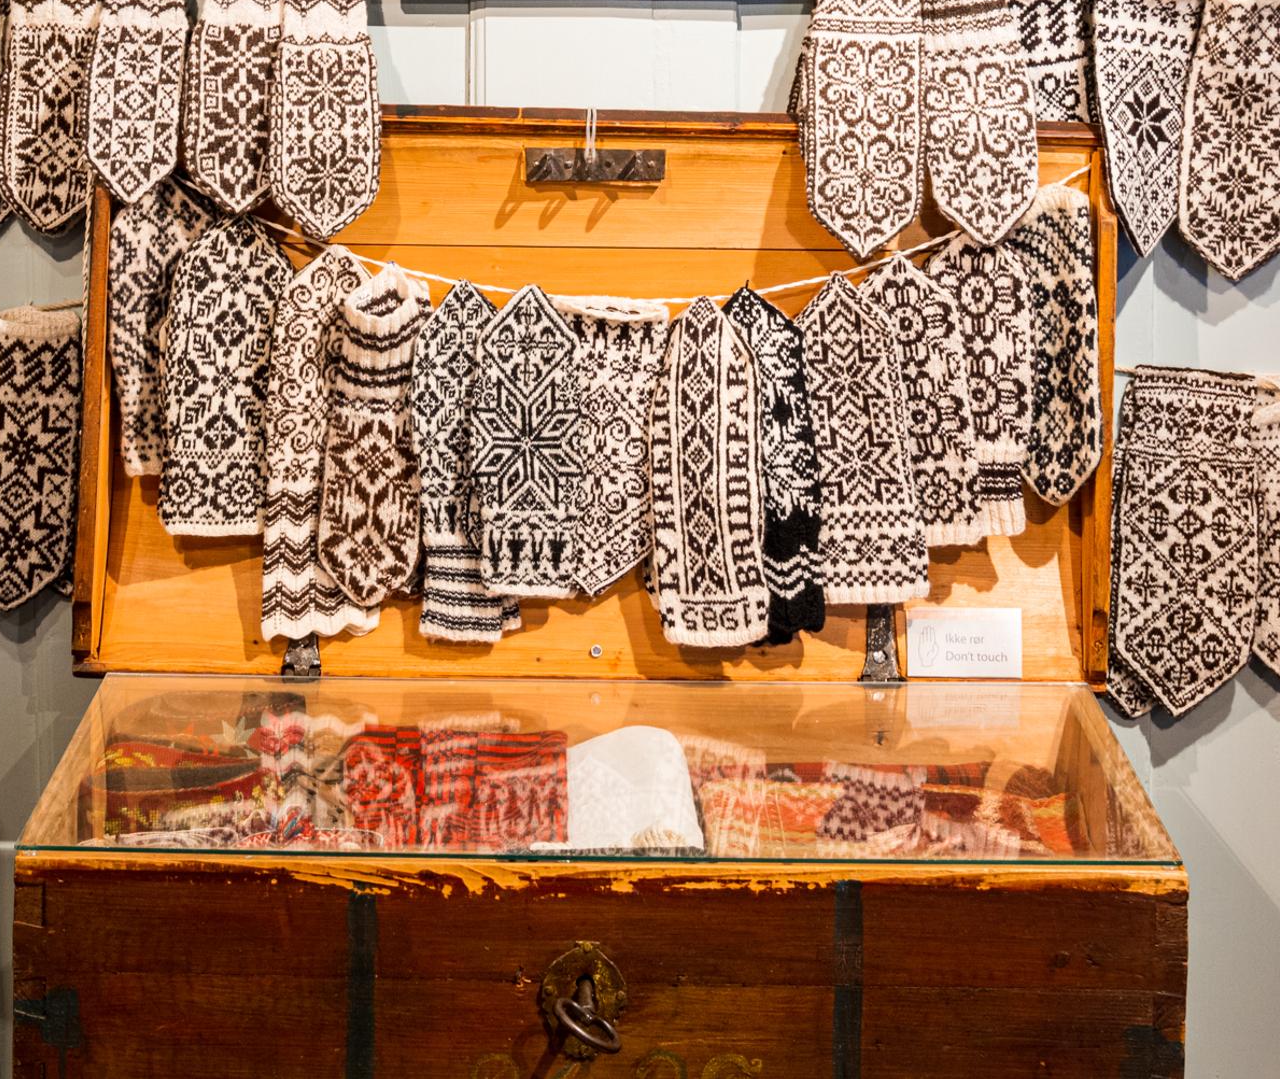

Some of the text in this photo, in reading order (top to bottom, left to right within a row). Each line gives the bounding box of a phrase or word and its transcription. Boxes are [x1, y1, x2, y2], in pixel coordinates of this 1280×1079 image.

[727, 362, 765, 591] BRUDEPAR
[681, 602, 751, 631] 1985
[945, 633, 984, 644] Ikke rør
[945, 651, 1008, 662] Don't touch
